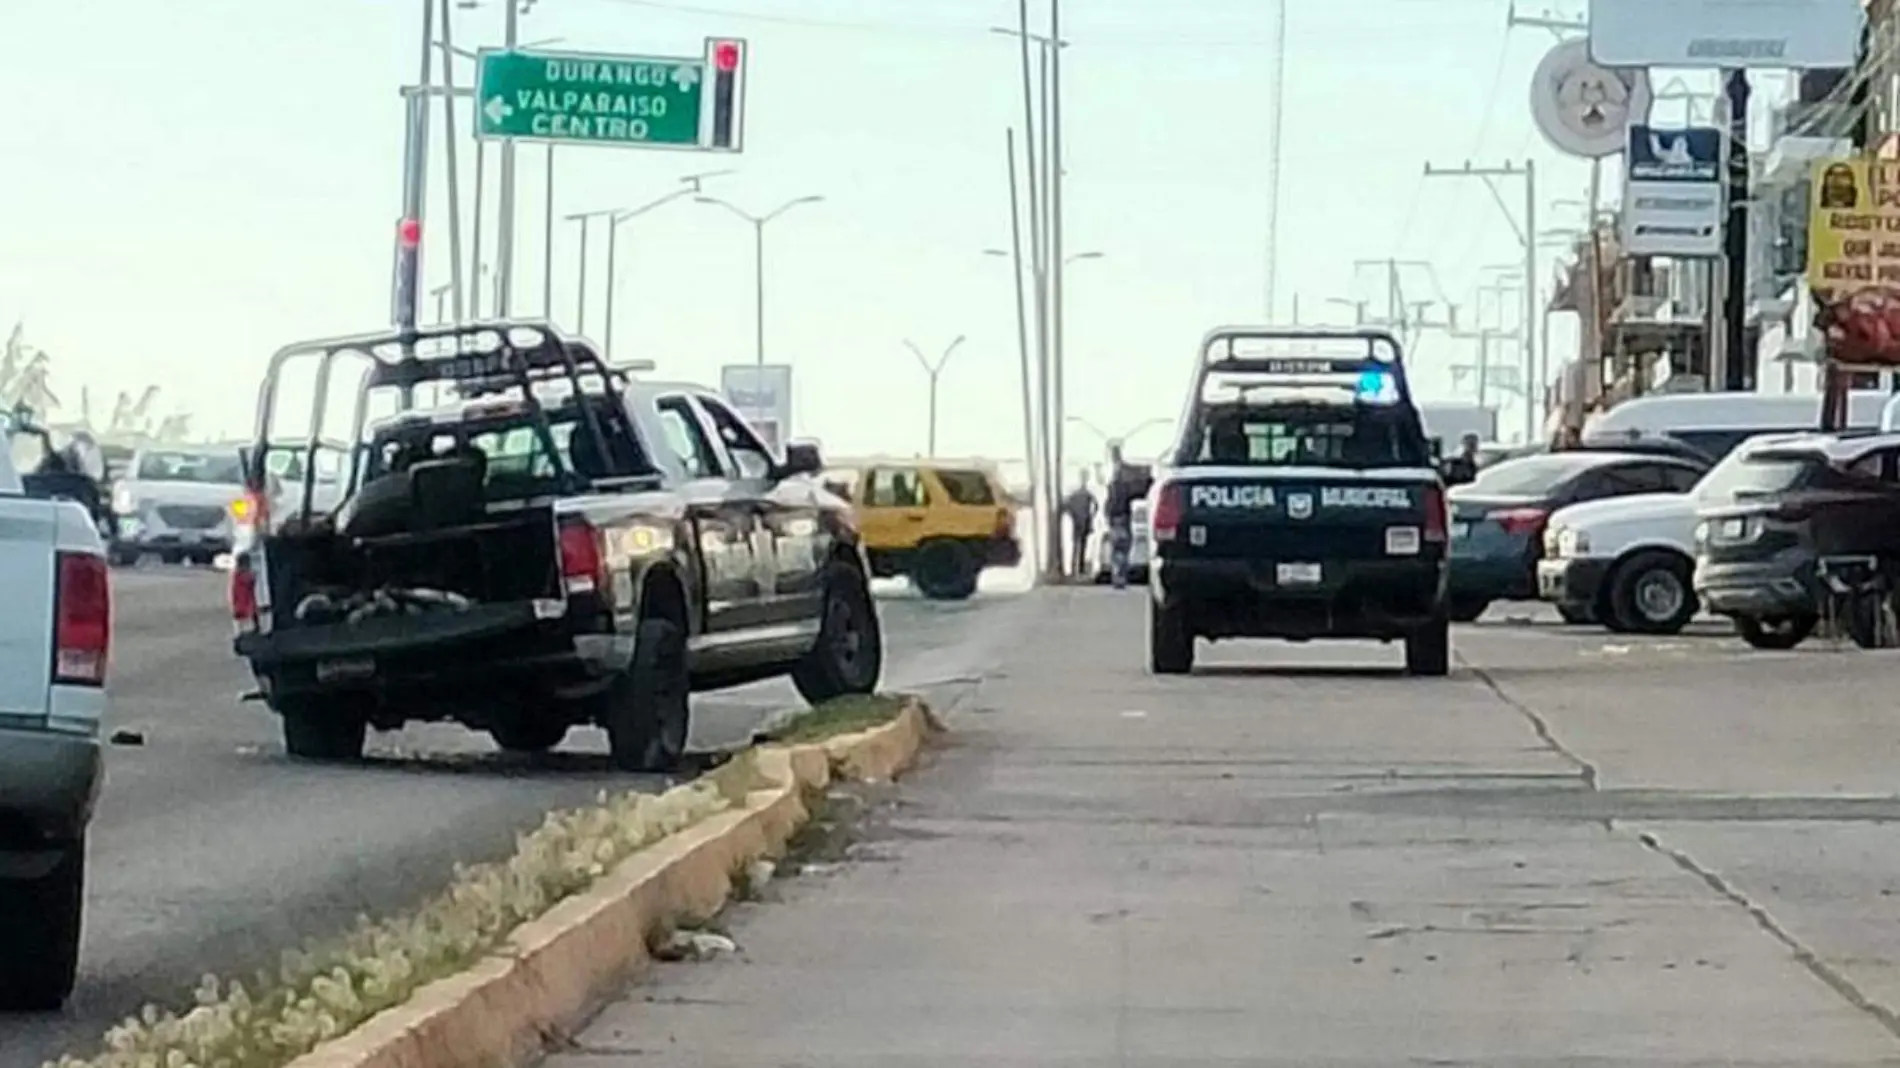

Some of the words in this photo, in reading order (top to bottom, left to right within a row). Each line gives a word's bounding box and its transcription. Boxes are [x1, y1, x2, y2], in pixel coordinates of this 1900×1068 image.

[546, 60, 667, 87] DURANGO
[516, 89, 667, 117] VALPARAISO
[531, 112, 649, 139] CENTRO
[1321, 486, 1411, 508] MUNICIPAL
